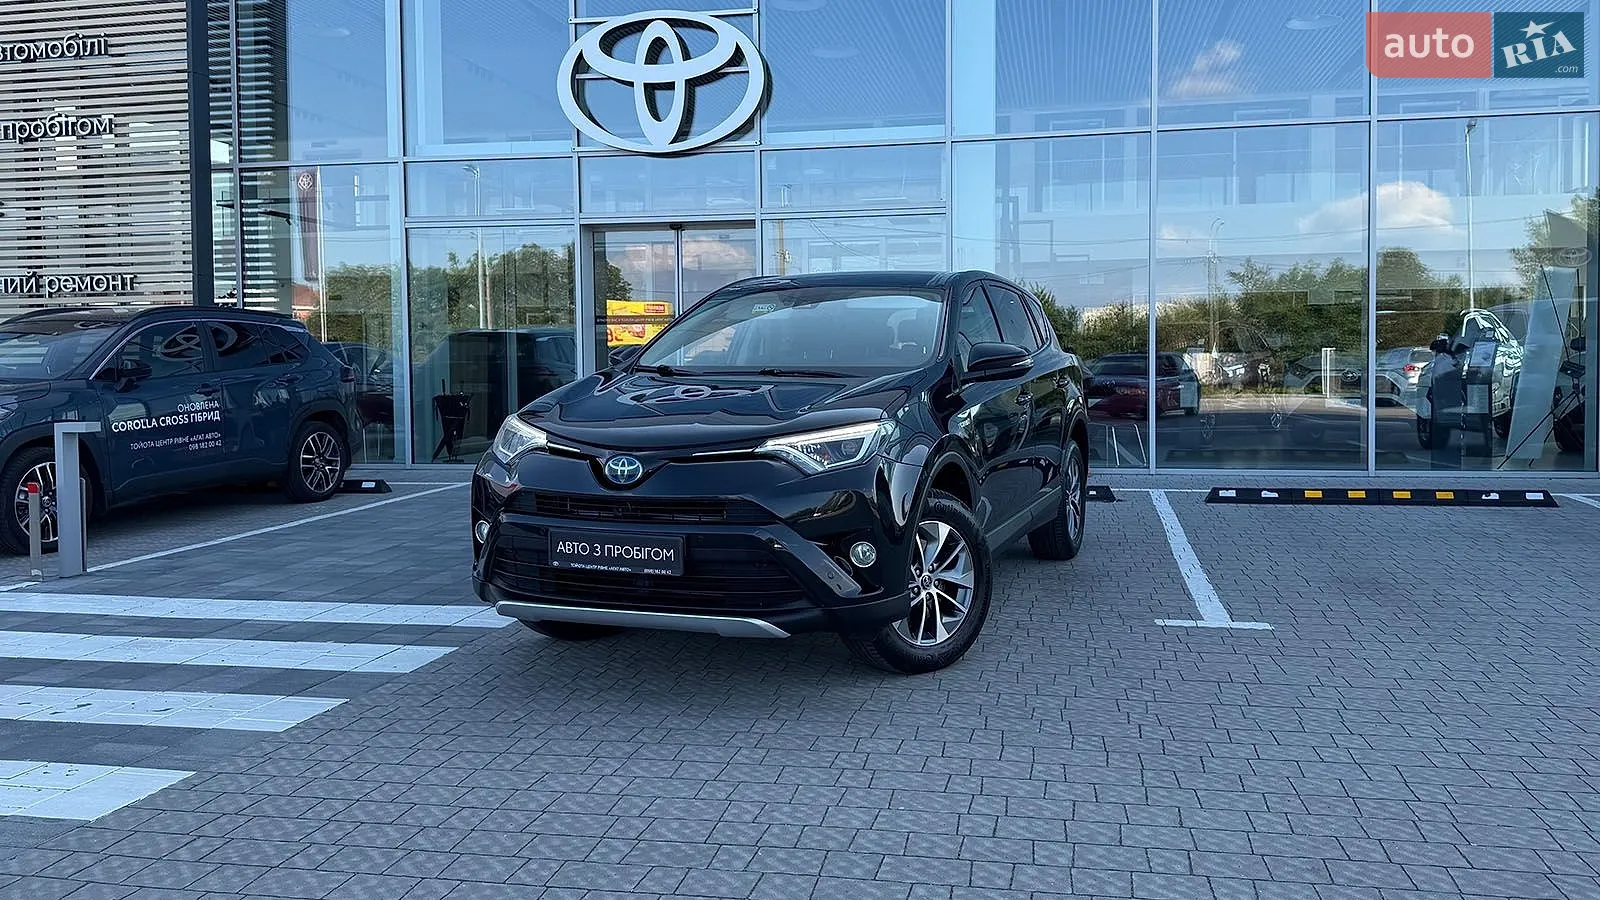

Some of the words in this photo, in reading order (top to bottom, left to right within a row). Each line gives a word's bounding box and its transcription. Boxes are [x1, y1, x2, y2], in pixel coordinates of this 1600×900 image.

[1, 113, 111, 143] пробігом
[45, 275, 134, 298] ремонт
[177, 400, 220, 412] ОНОВЛЕНА
[111, 418, 158, 432] COROLLA
[159, 414, 189, 427] CROSS
[190, 410, 221, 423] ГІБРИД
[130, 440, 155, 450] ТОЙОТА
[155, 438, 173, 448] ЦЕНТР
[556, 541, 590, 555] АВТО
[604, 544, 674, 561] ПРОБІГОМ
